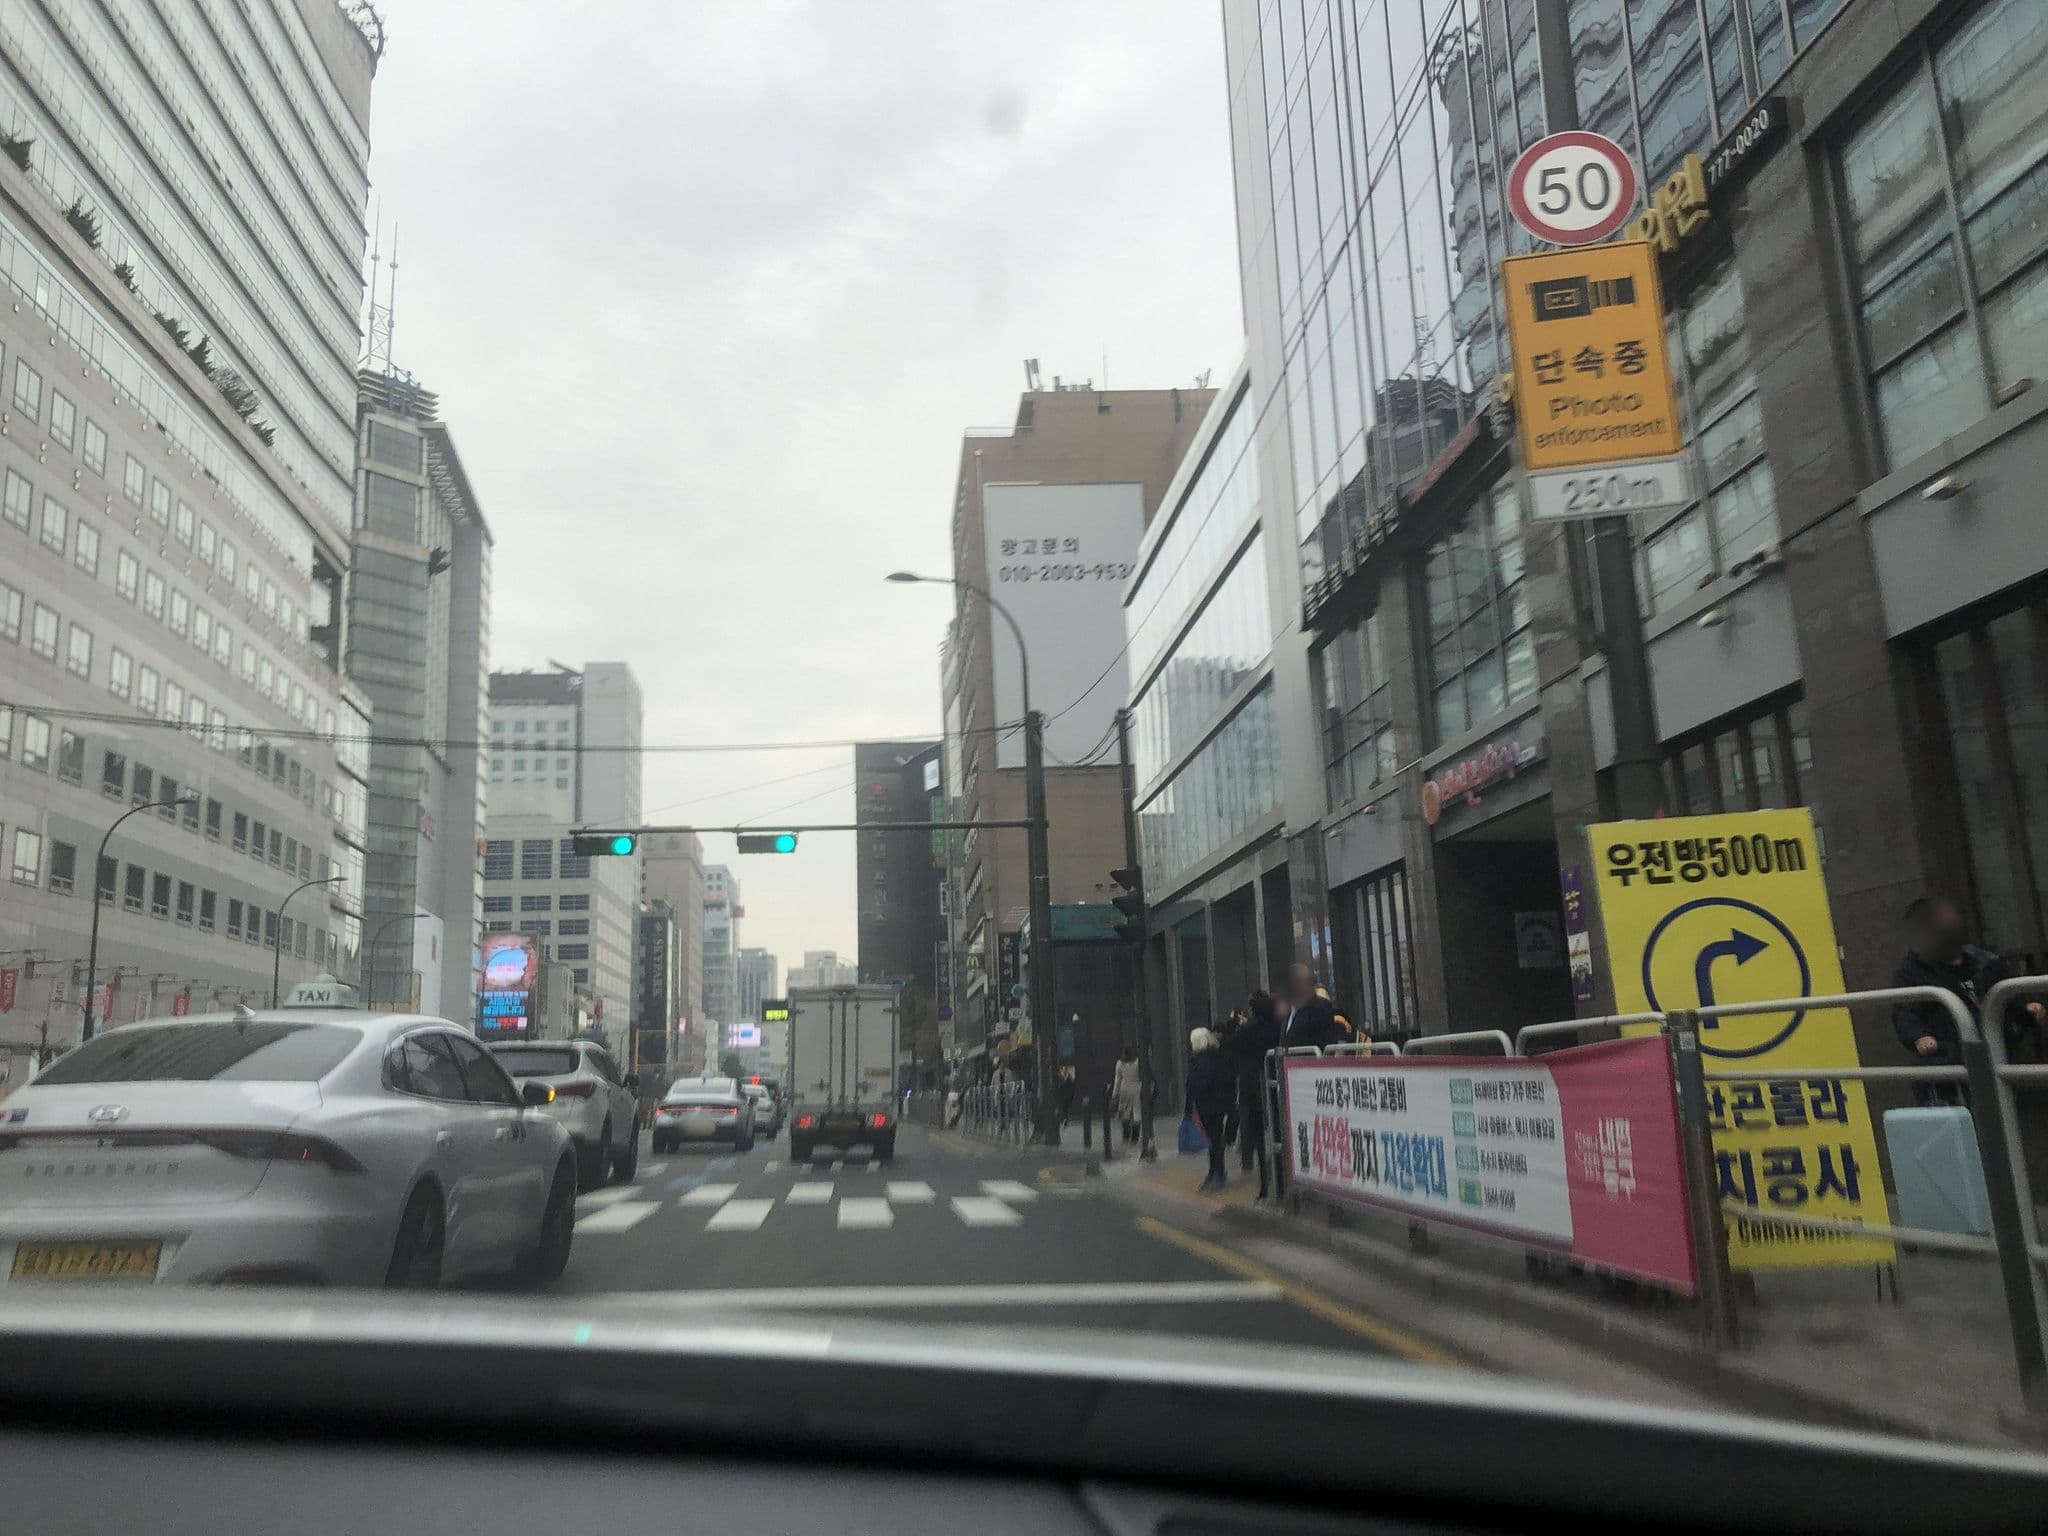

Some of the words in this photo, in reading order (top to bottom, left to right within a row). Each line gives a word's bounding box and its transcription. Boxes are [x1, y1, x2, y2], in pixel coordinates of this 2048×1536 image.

[1708, 109, 1770, 186] 777-0020
[1537, 162, 1611, 215] 50
[1531, 340, 1647, 386] 단속중
[1549, 393, 1642, 420] Photo
[1535, 417, 1666, 449] enforcement
[1562, 474, 1661, 511] 250m
[1001, 537, 1079, 556] 광고문의
[1607, 833, 1808, 886] 우전방500m
[296, 990, 331, 1002] TAXI
[1352, 1077, 1378, 1112] 어르신
[1379, 1077, 1407, 1112] 교통비
